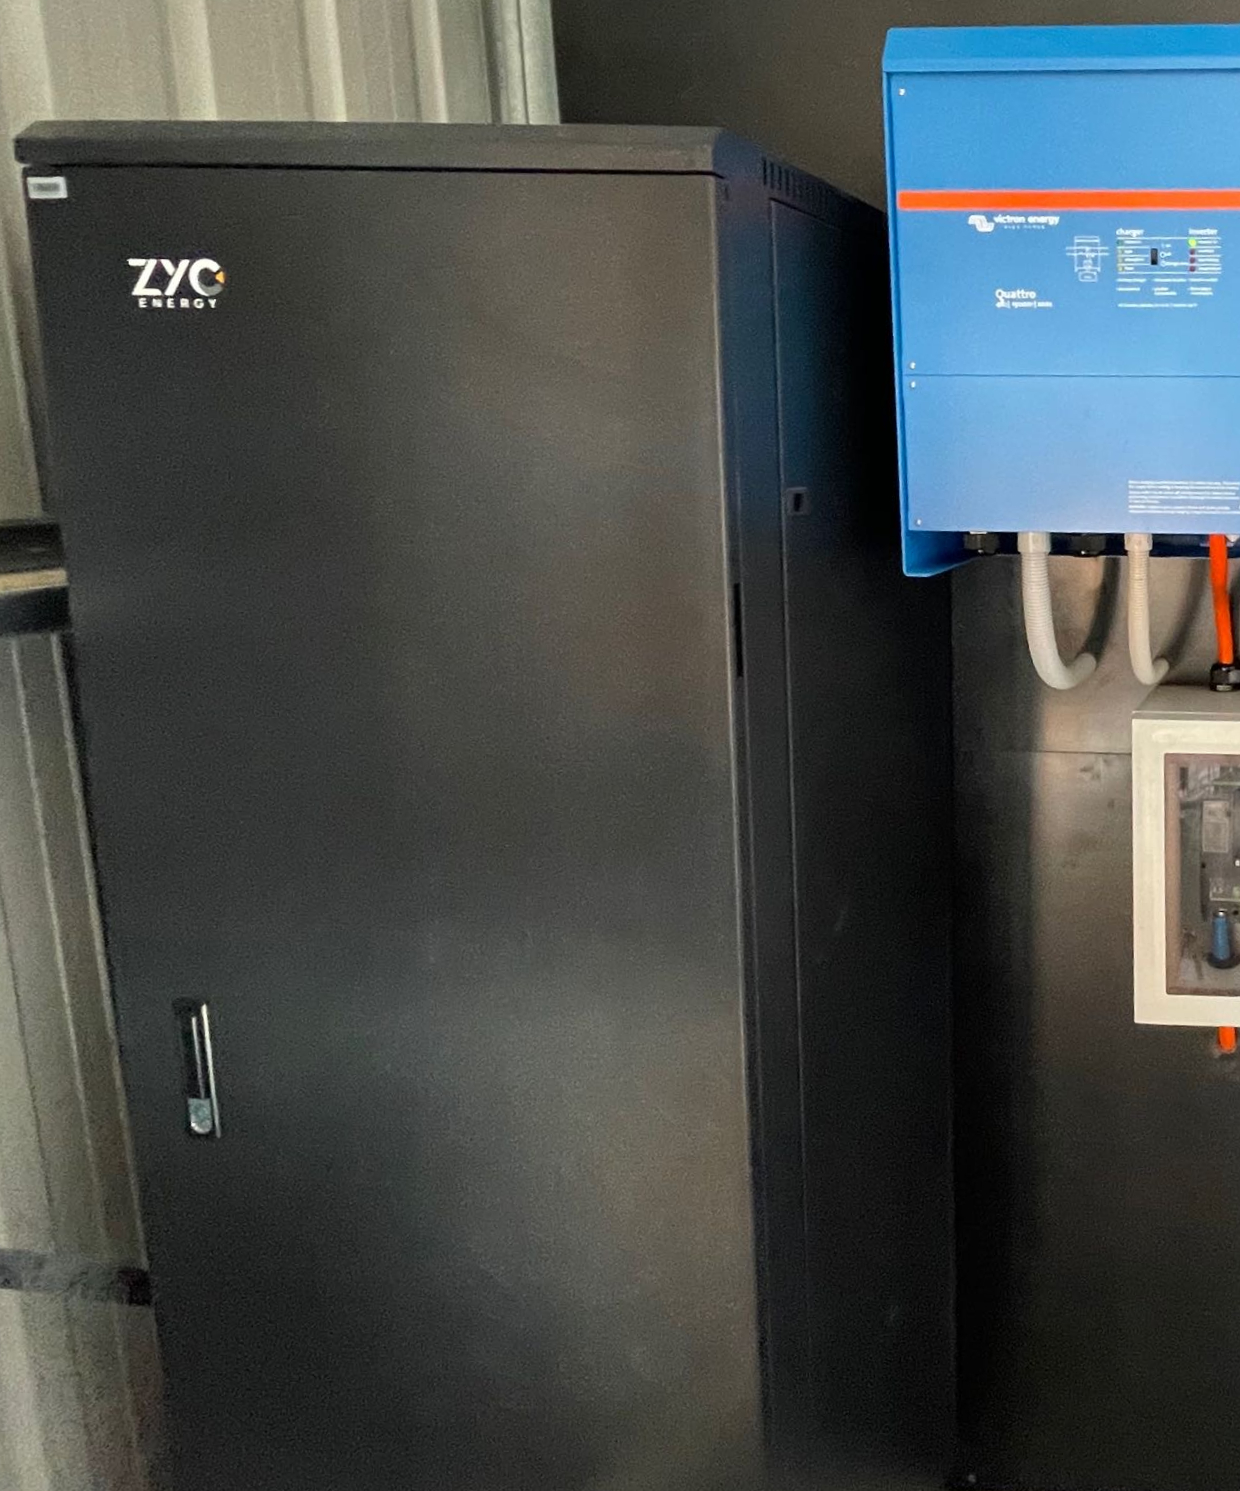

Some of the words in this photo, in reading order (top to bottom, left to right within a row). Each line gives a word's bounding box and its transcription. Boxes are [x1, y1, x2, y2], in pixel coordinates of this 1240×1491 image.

[993, 214, 1026, 223] victron
[1027, 215, 1060, 225] energy
[127, 258, 225, 297] ZYC
[995, 289, 1036, 302] Quattro
[138, 298, 217, 309] ENERGY
